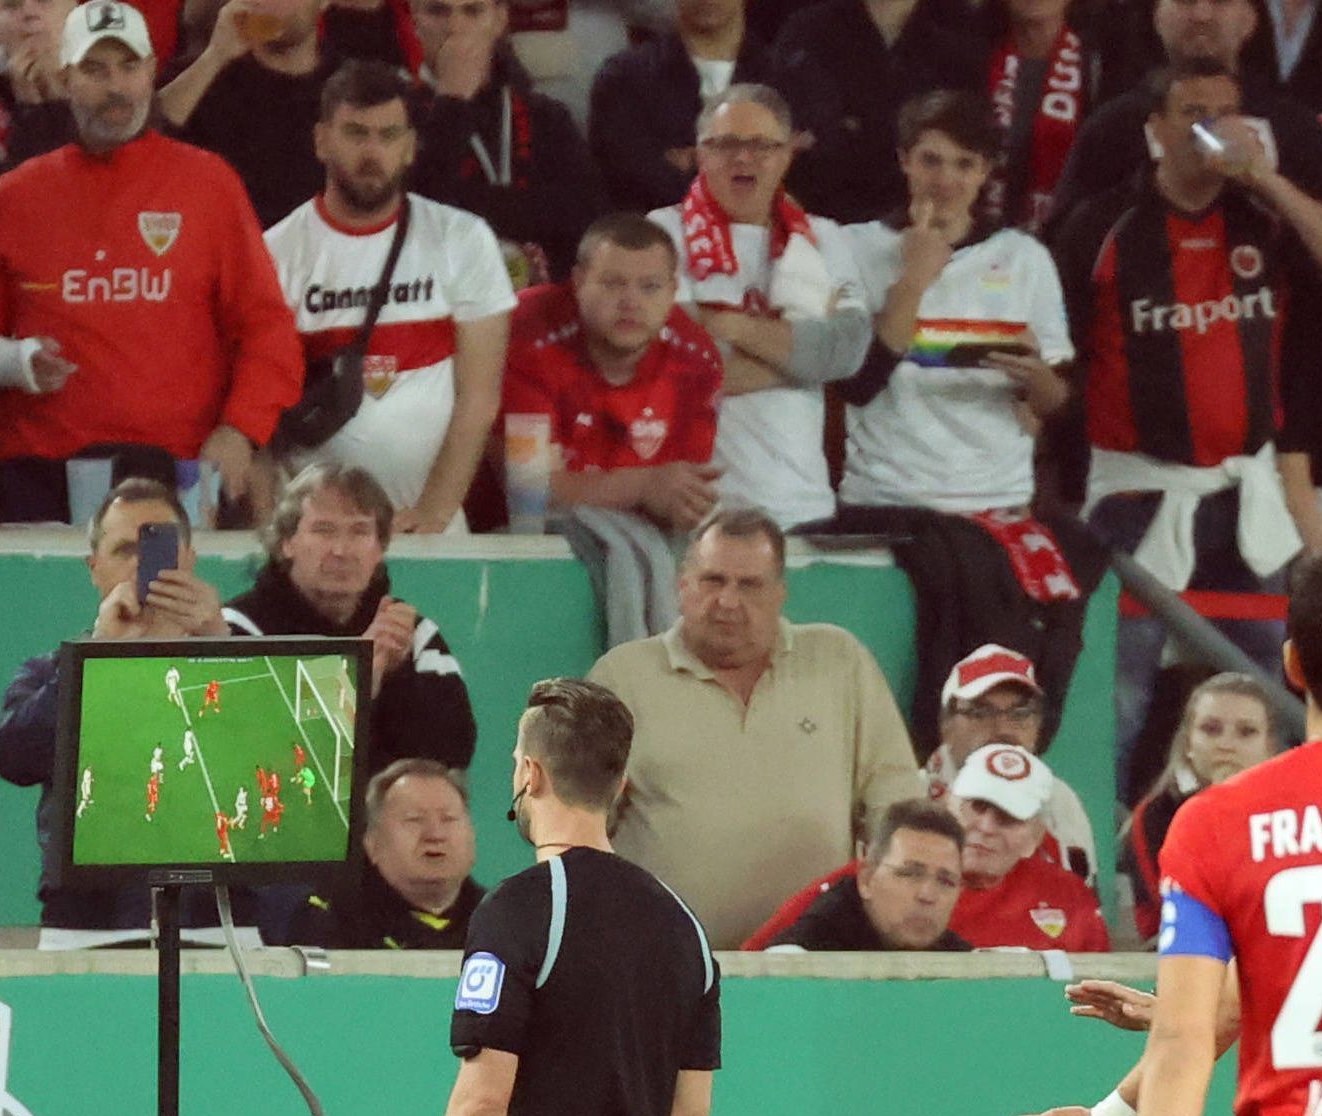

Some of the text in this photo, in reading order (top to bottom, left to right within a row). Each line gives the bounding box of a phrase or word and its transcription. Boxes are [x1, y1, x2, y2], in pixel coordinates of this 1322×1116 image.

[61, 267, 173, 303] EnBW
[305, 275, 434, 315] Cannatt
[1130, 286, 1278, 335] Fraport
